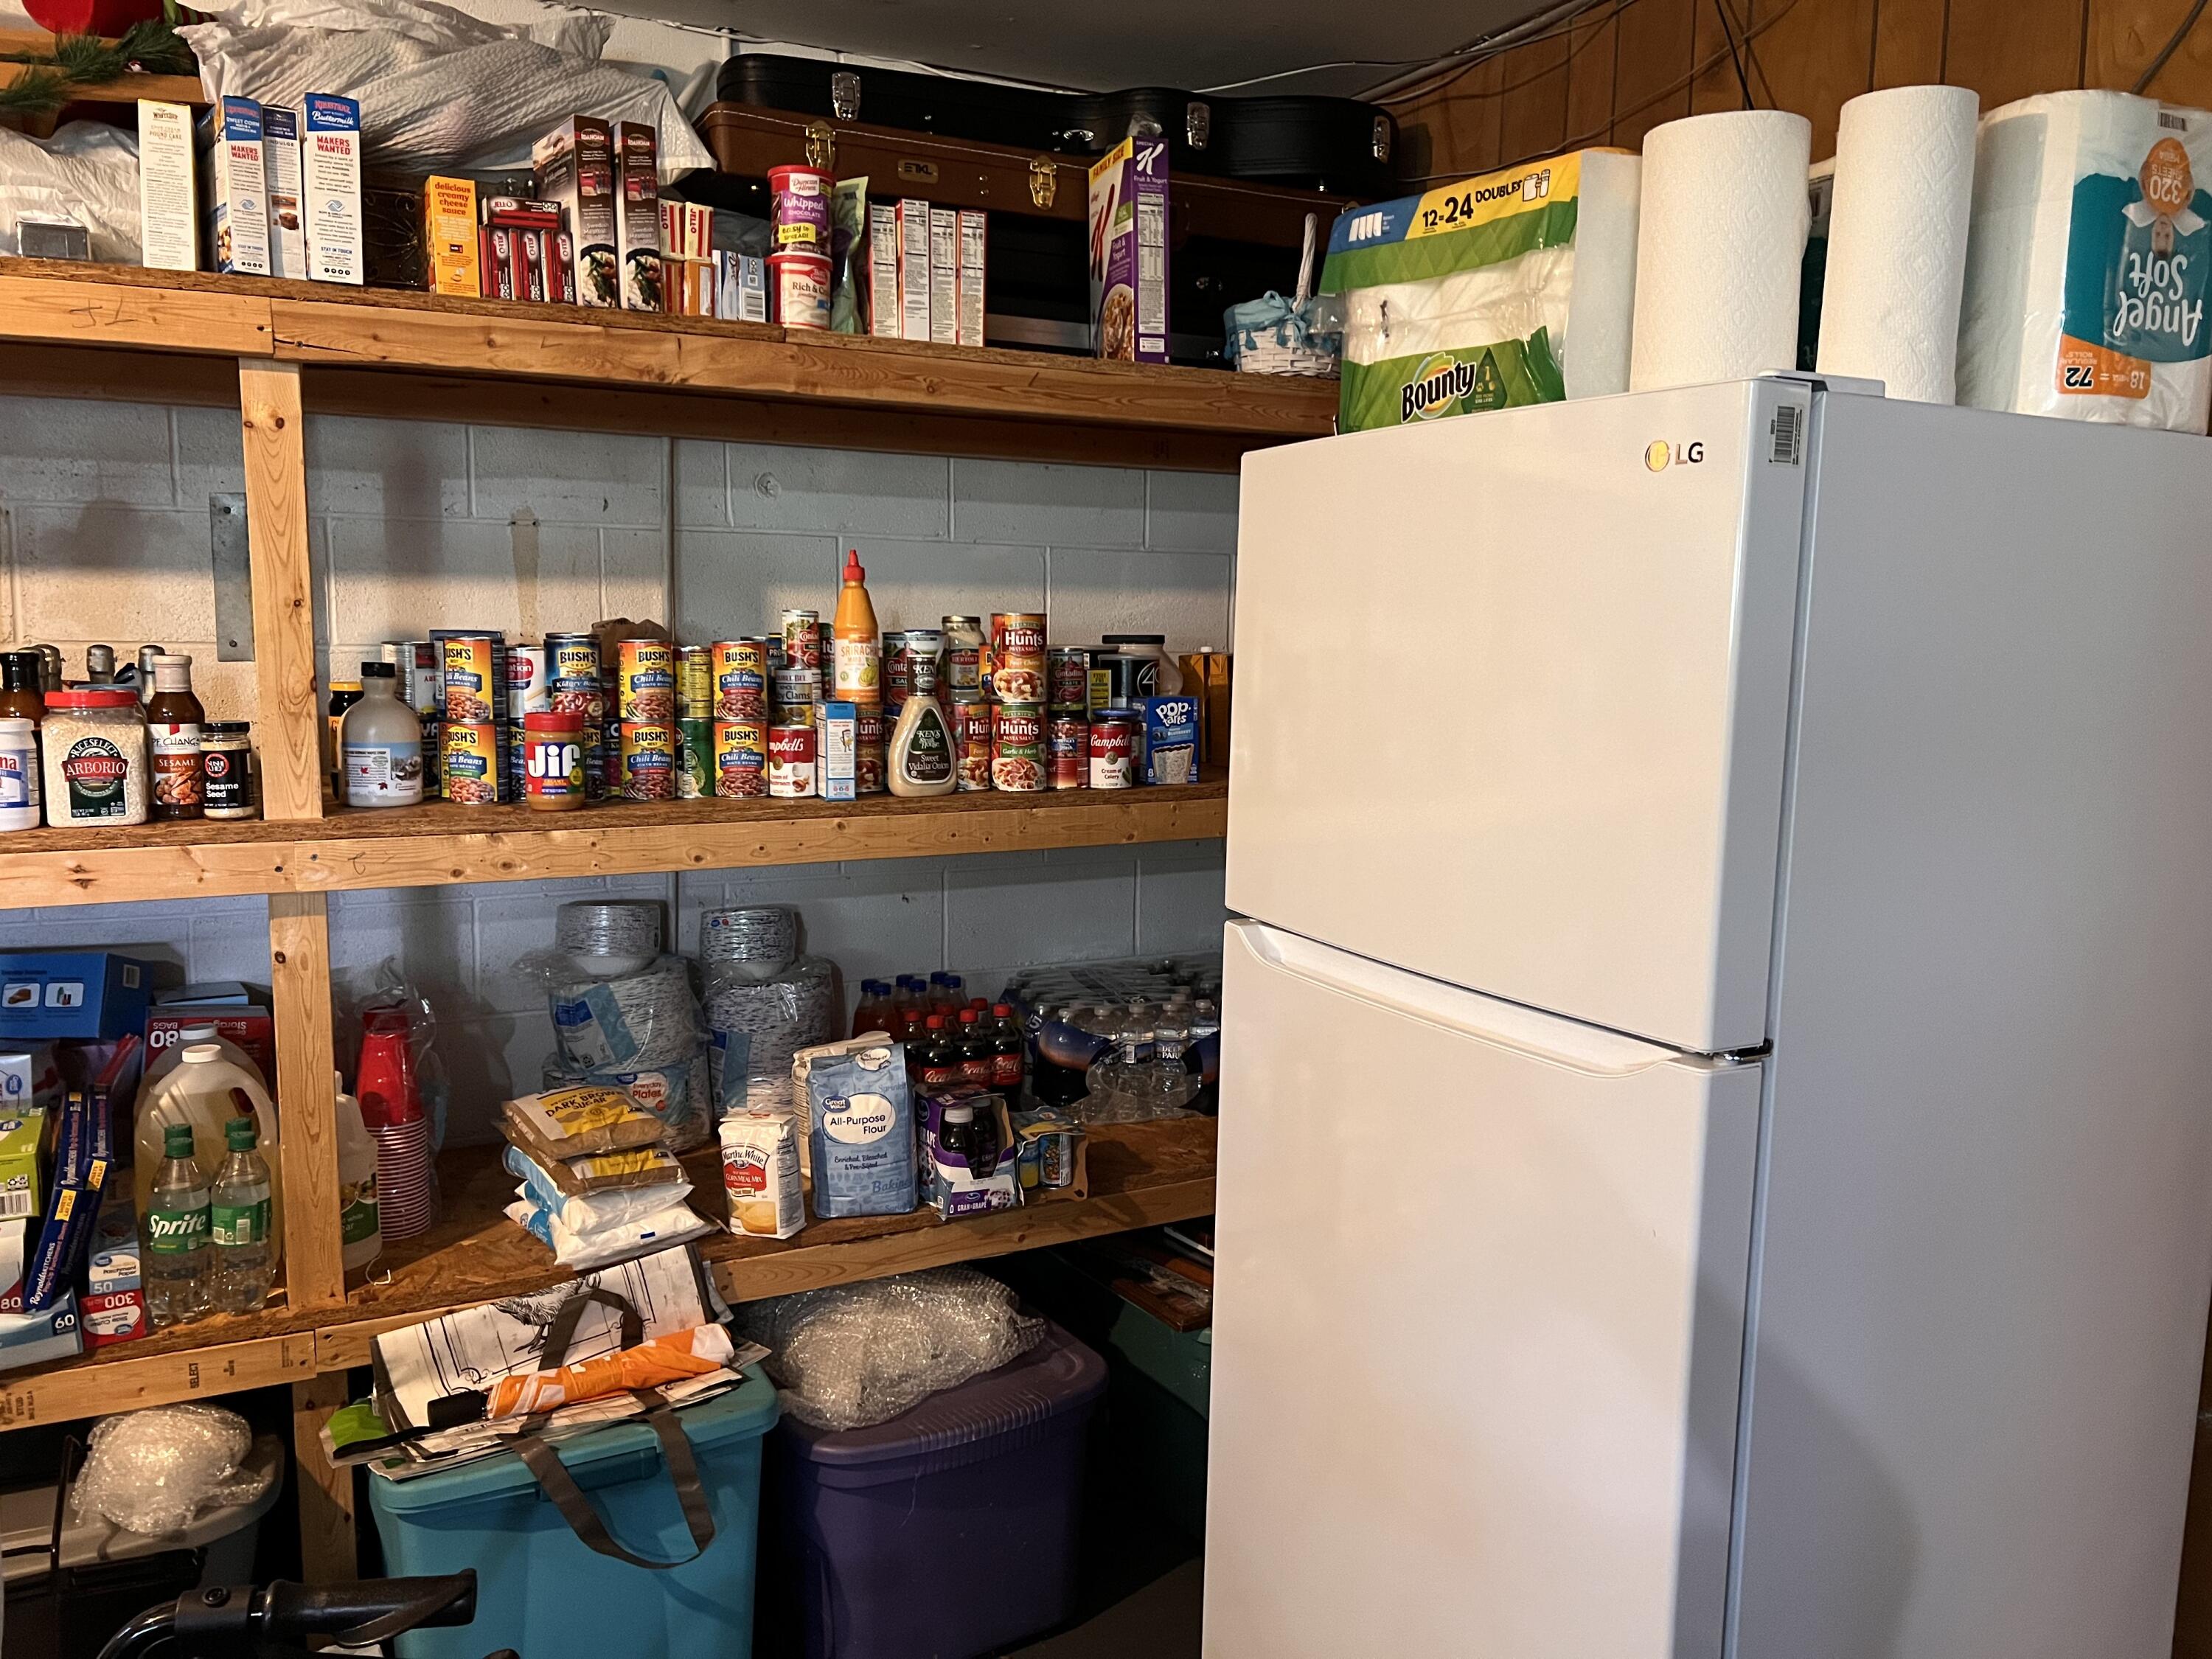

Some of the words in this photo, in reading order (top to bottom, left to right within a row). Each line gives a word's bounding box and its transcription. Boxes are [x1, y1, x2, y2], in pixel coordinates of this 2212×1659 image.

[312, 111, 354, 125] Buttermilk
[316, 135, 350, 147] MAKERS
[231, 145, 258, 155] MAKERS
[317, 144, 350, 155] WANTED
[2158, 150, 2180, 161] MEGA
[232, 152, 258, 161] WANTED
[1093, 159, 1110, 179] FAMILY
[1112, 145, 1124, 164] SIZE
[1136, 143, 1164, 175] K
[2151, 164, 2184, 180] SHEETS
[1152, 176, 1167, 184] Yogurt
[435, 182, 471, 193] delicious
[1475, 179, 1523, 203] DOUBLES
[2149, 175, 2181, 204] 320
[437, 192, 469, 202] creamy
[439, 198, 468, 208] cheese
[784, 196, 824, 211] Whipped
[442, 207, 466, 215] sauce
[788, 210, 821, 218] CHOCOLATE
[2129, 252, 2188, 301] Soft
[793, 282, 810, 292] Rich
[812, 285, 818, 293] &
[2114, 291, 2202, 347] Angel
[2065, 366, 2093, 388] 72
[2129, 370, 2146, 390] 18
[1402, 362, 1475, 422] Bounty
[1675, 442, 1703, 465] LG
[1005, 630, 1043, 647] Hunt's
[445, 648, 470, 661] USH'S
[639, 651, 669, 663] BUSH'S
[725, 651, 759, 663] BUSH'S
[841, 645, 878, 657] SRIRACHA
[560, 651, 597, 664] BUSH'S
[453, 672, 478, 682] Beans
[634, 675, 654, 684] Chili
[722, 675, 740, 684] Chili
[556, 680, 580, 688] Kidney
[786, 692, 810, 700] Clams
[917, 730, 940, 738] KEN'S
[1000, 720, 1039, 736] Hunt's
[448, 731, 476, 744] USH'S
[635, 731, 668, 743] BUSH'S
[724, 731, 759, 742] BUSH'S
[72, 738, 117, 757] RICESELECT
[159, 759, 195, 767] SESAME
[459, 756, 482, 765] Beans
[527, 744, 580, 777] Jif
[630, 754, 650, 763] Chili
[721, 754, 739, 762] Chili
[740, 753, 762, 761] Beans
[66, 762, 125, 776] ARBORIO
[908, 762, 931, 771] Vidalia
[932, 762, 949, 771] Onion
[1147, 768, 1154, 777] 8
[206, 782, 239, 790] Sesame
[150, 1031, 178, 1048] 80
[633, 1089, 662, 1099] Plates
[546, 1099, 580, 1117] DARK
[580, 1091, 625, 1102] BROWN
[573, 1097, 607, 1110] SUGAR
[825, 1099, 846, 1107] Great
[830, 1114, 886, 1126] All-Purpose
[863, 1124, 887, 1134] Flour
[723, 1149, 743, 1160] Martha
[745, 1149, 764, 1166] White
[834, 1155, 860, 1164] Enriched,
[862, 1152, 887, 1162] Bleached
[752, 1175, 762, 1183] MIX
[957, 1203, 970, 1211] CRAN
[972, 1201, 987, 1210] GRAPE
[149, 1213, 206, 1239] Sprite
[103, 1265, 136, 1274] Parchment
[29, 1274, 46, 1305] Reynolds
[94, 1281, 113, 1293] 50
[1, 1296, 21, 1310] 80
[105, 1293, 135, 1308] 300
[55, 1314, 74, 1328] 60
[189, 1363, 200, 1388] SELECT
